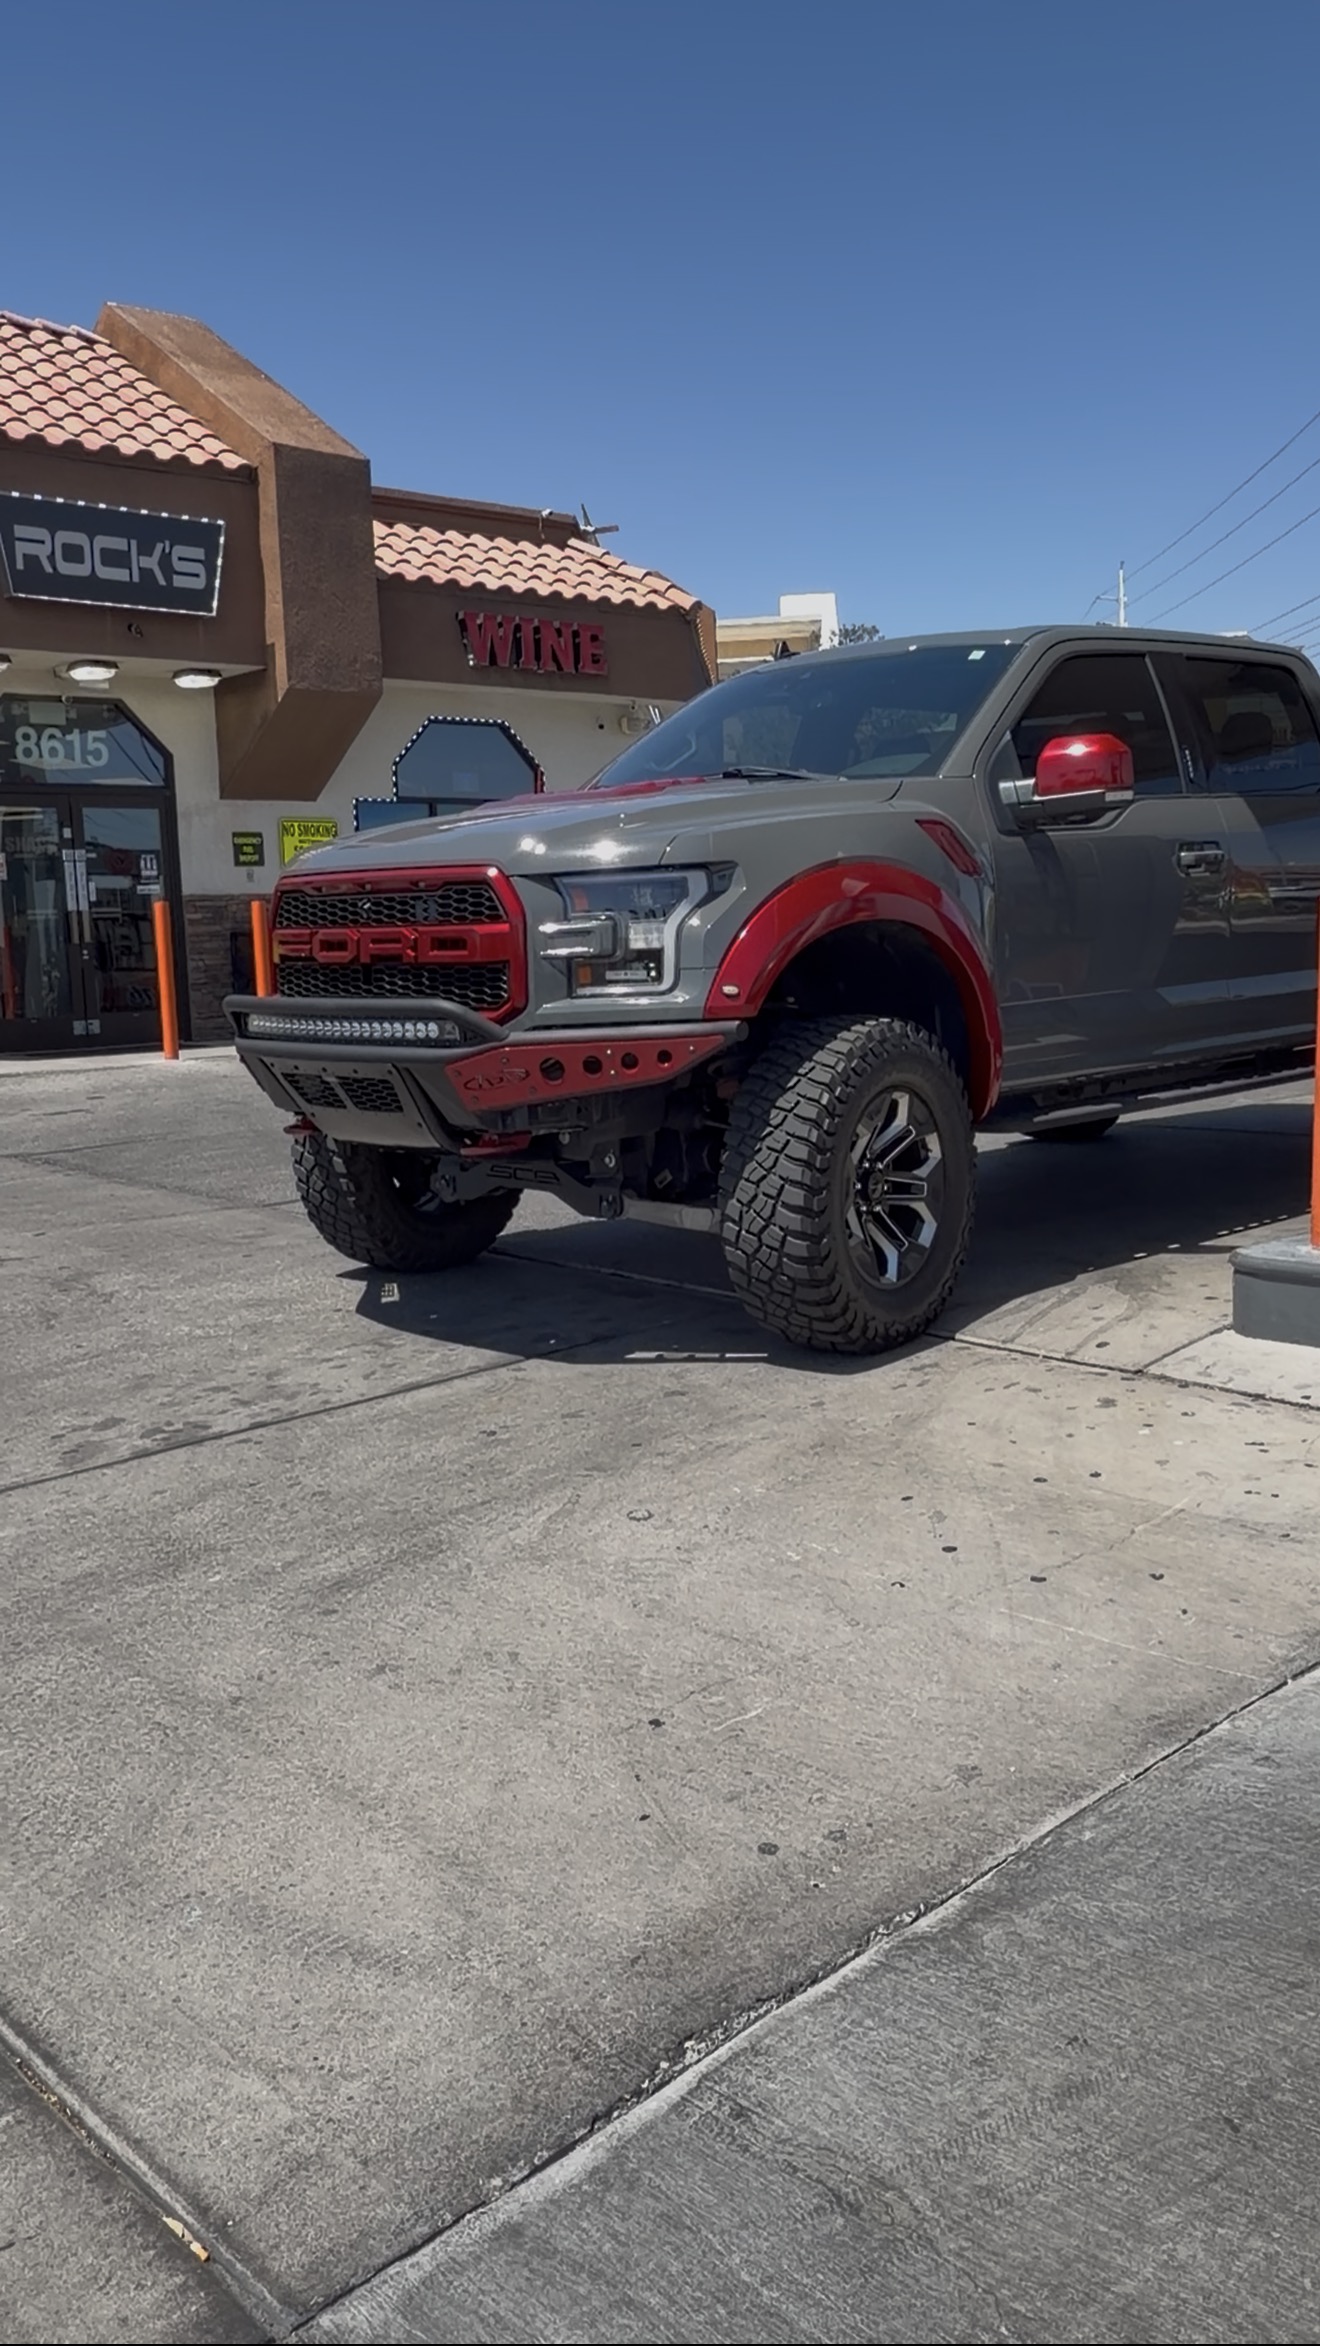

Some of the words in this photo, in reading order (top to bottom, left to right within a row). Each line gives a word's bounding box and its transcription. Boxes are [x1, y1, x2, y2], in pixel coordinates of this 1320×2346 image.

[13, 524, 207, 590] ROCK'S
[462, 611, 608, 676] WINE
[15, 726, 109, 767] 8615
[282, 823, 295, 837] NO
[297, 823, 338, 839] SMOKING
[272, 924, 481, 964] FORD
